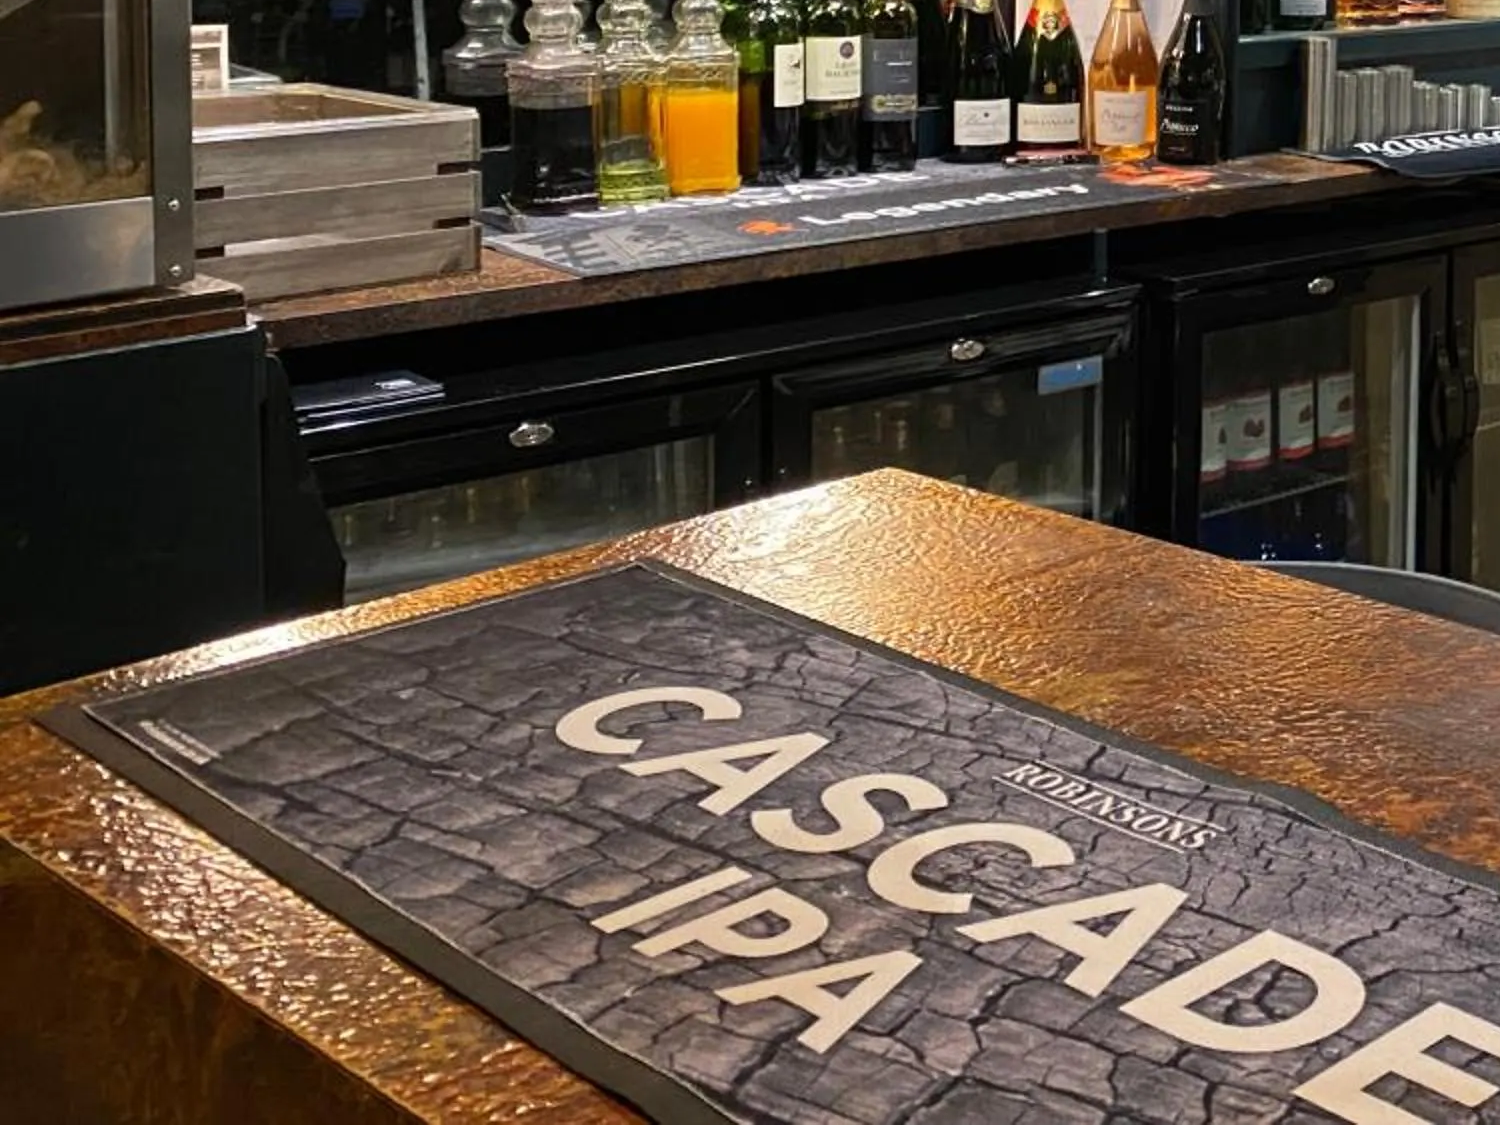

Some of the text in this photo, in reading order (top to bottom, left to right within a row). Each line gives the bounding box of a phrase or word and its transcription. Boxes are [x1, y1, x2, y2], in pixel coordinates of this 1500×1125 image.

[798, 183, 1089, 226] Legendary
[1003, 762, 1217, 850] ROBINSONS
[590, 866, 923, 1055] IPA
